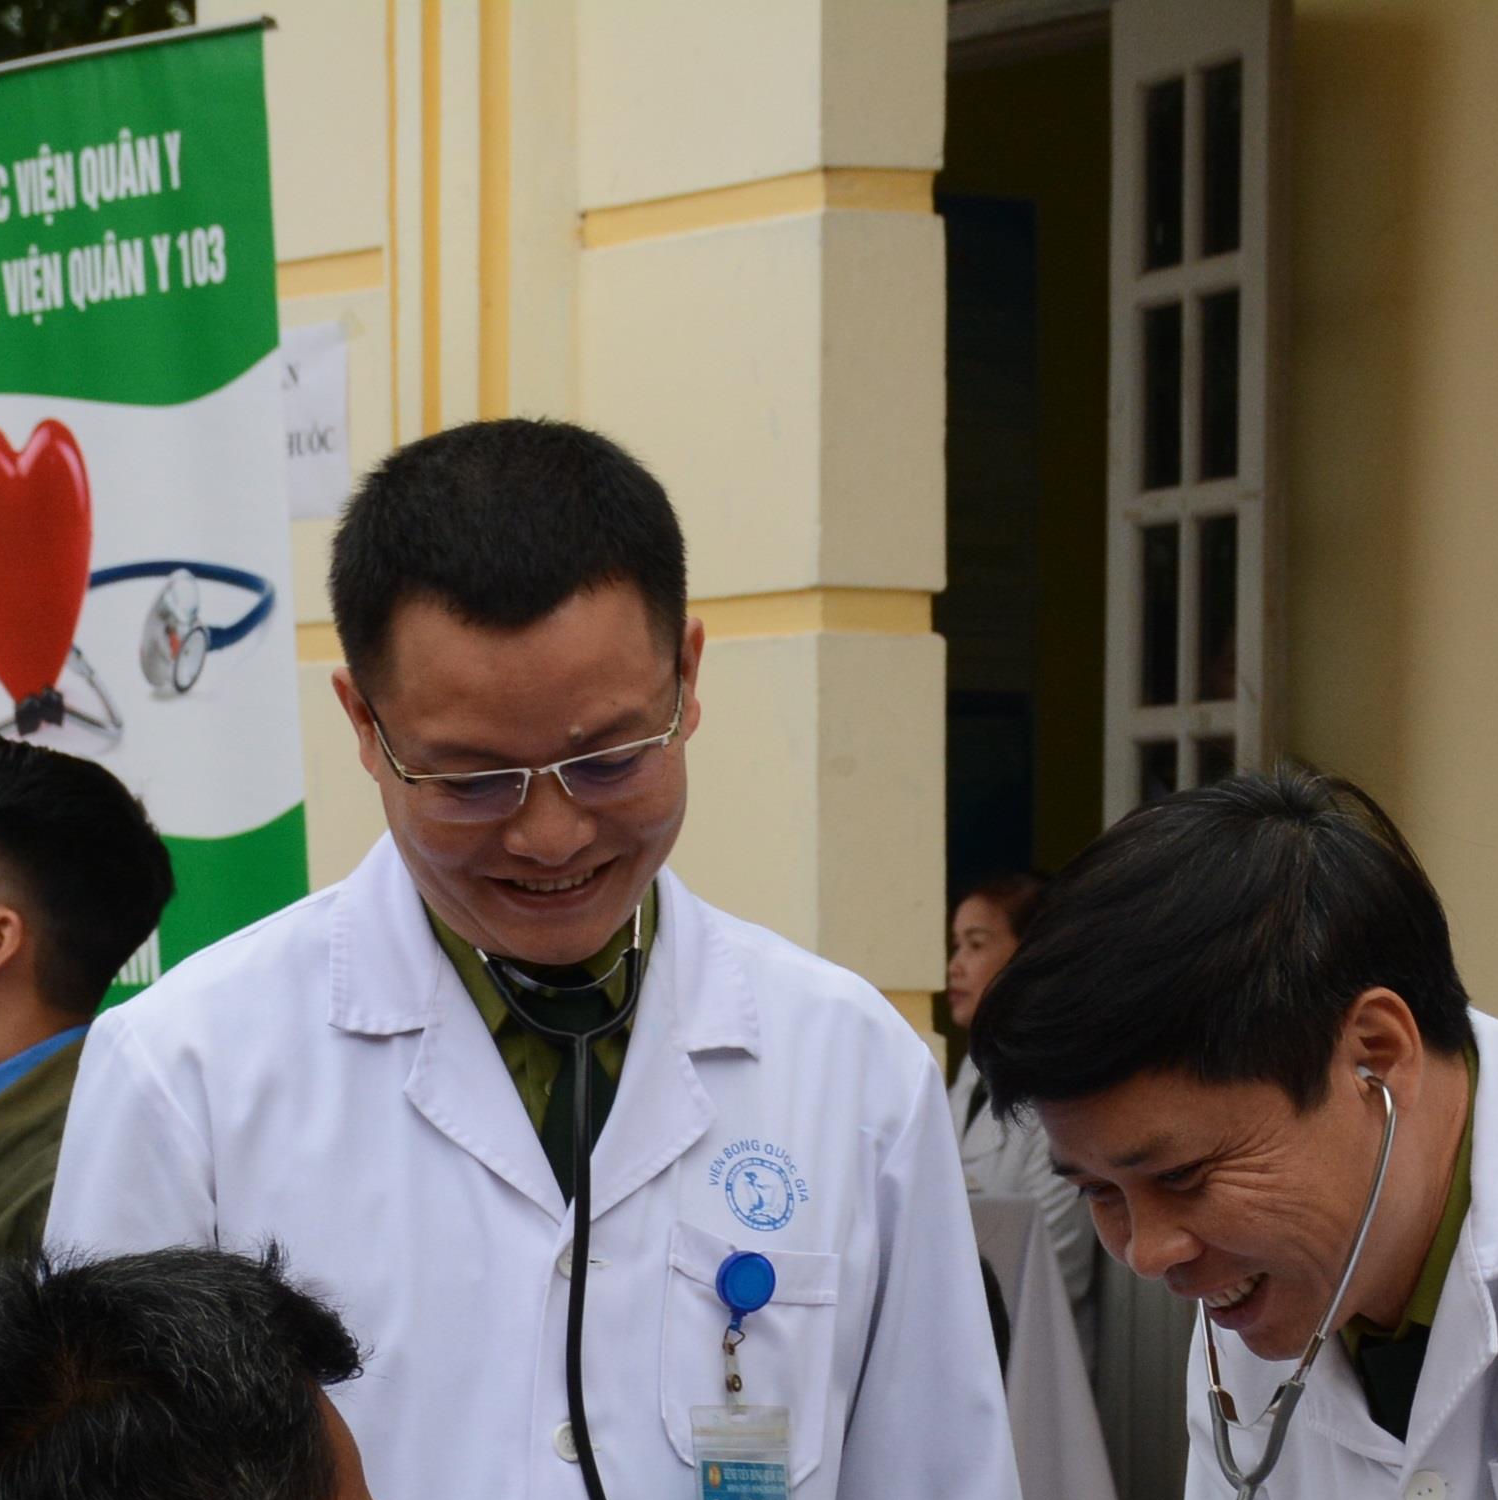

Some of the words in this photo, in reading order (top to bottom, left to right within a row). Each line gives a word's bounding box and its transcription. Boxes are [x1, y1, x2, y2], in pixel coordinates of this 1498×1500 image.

[14, 144, 76, 226] VIỆN
[79, 127, 162, 211] QUÂN
[165, 130, 182, 190] Y
[1, 244, 65, 326] VIỆN
[67, 229, 146, 313] QUÂN
[151, 233, 173, 293] Y
[176, 224, 227, 290] 103
[794, 1178, 809, 1203] GIA
